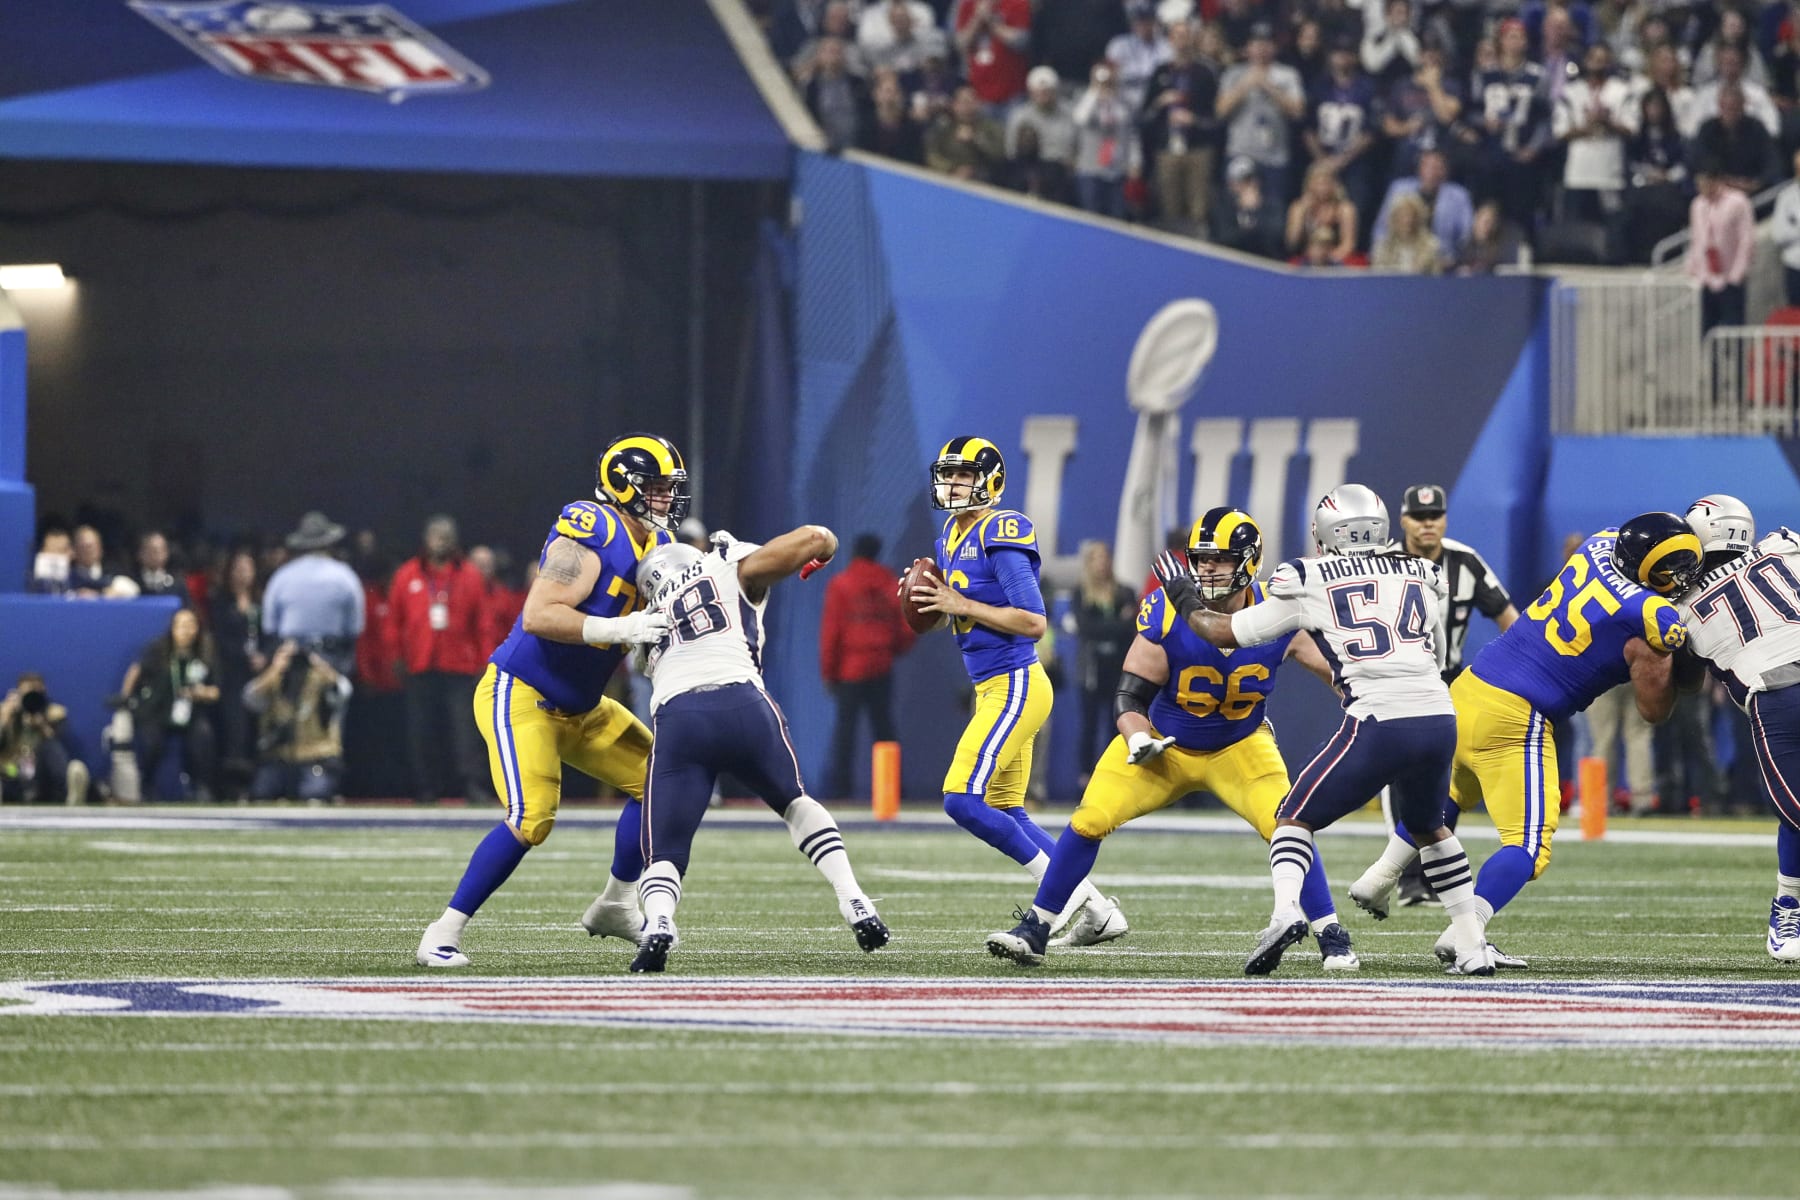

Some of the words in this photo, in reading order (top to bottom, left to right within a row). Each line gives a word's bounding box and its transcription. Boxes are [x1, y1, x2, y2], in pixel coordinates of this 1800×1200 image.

[212, 36, 460, 84] NFL
[567, 507, 597, 532] 79
[997, 518, 1019, 538] 16
[1350, 530, 1371, 543] 54
[1727, 527, 1749, 542] 70
[645, 569, 662, 591] 98
[1317, 556, 1427, 583] HIGHTOWER
[1587, 539, 1644, 600] SULLIVAN
[943, 569, 976, 636] 6
[1526, 553, 1623, 657] 65
[1689, 552, 1800, 647] 70
[1327, 580, 1437, 662] 54
[1663, 622, 1689, 649] 65
[1176, 663, 1270, 721] 66
[850, 898, 869, 918] NIKE
